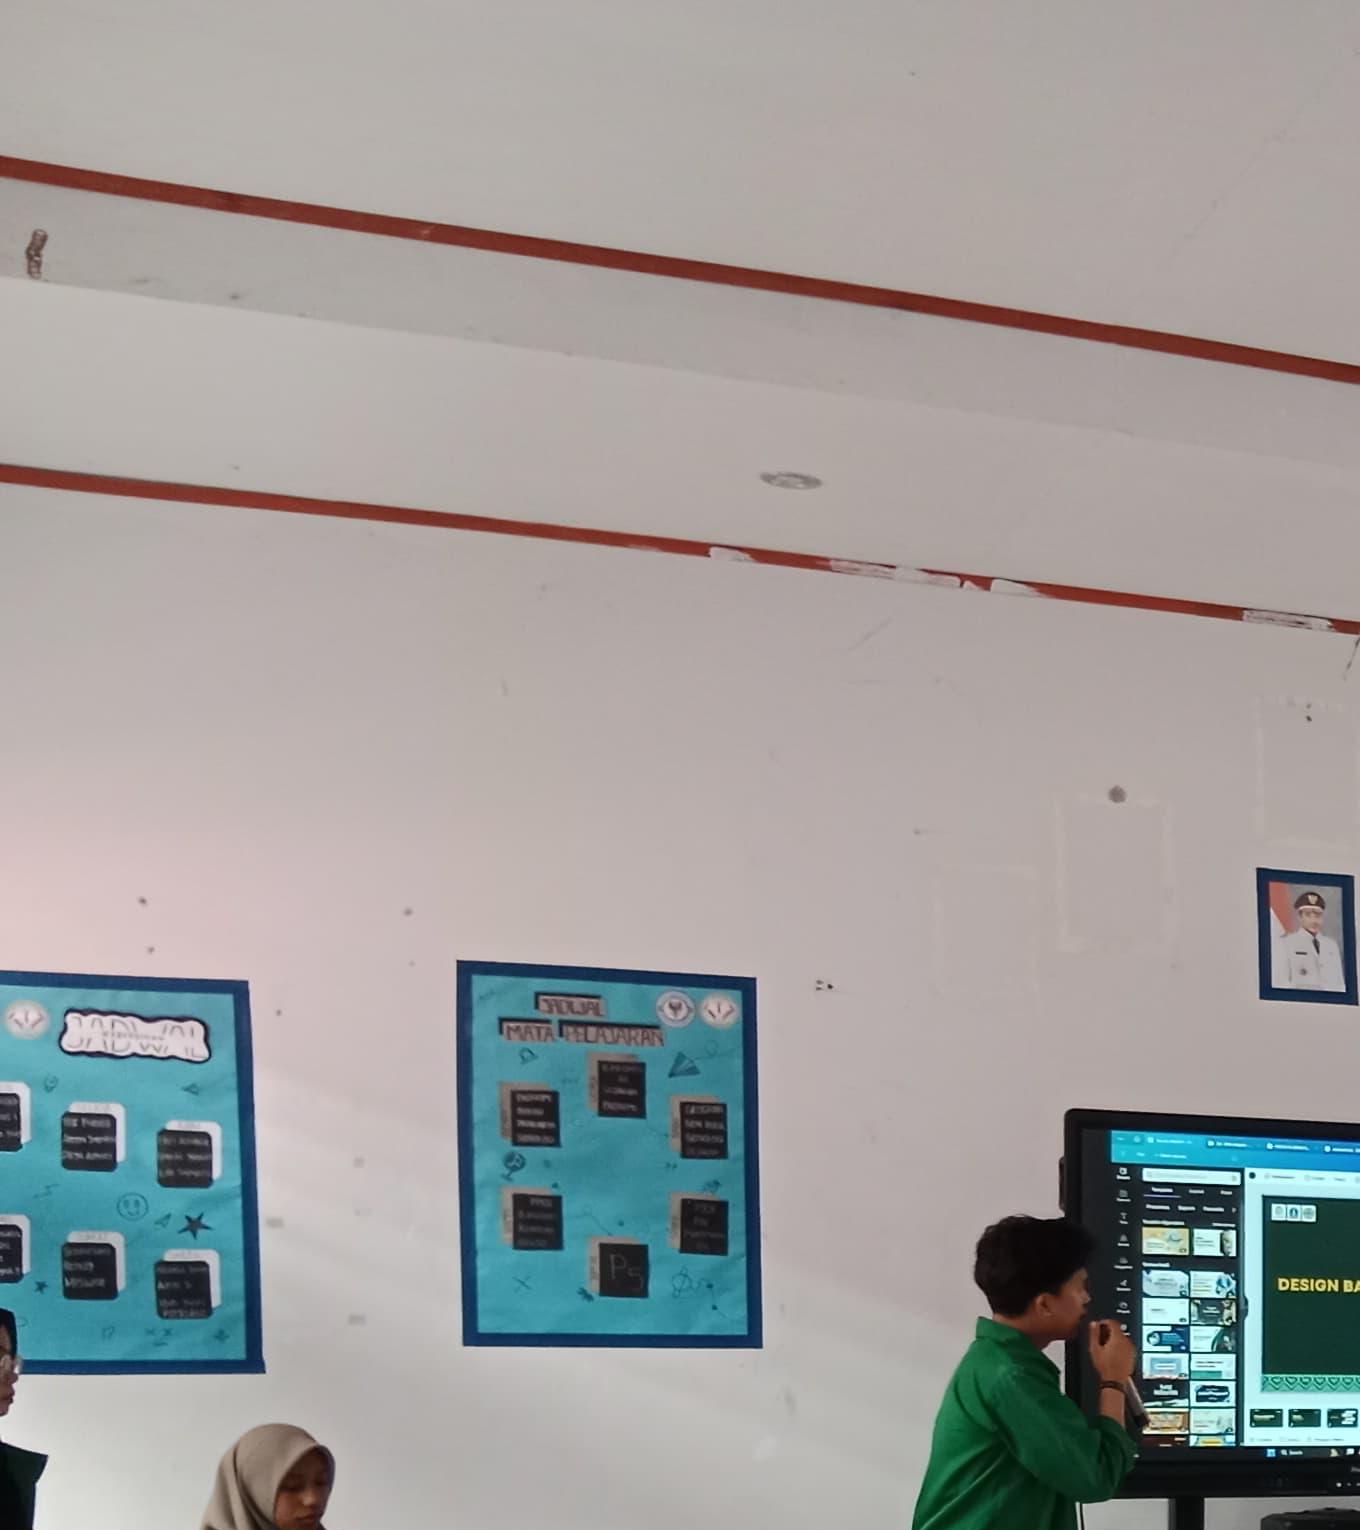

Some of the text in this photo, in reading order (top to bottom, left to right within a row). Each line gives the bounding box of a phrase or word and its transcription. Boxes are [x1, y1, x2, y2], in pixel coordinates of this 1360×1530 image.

[505, 1022, 665, 1047] MATA PELAJARAN
[1277, 1277, 1339, 1293] DESIGN
